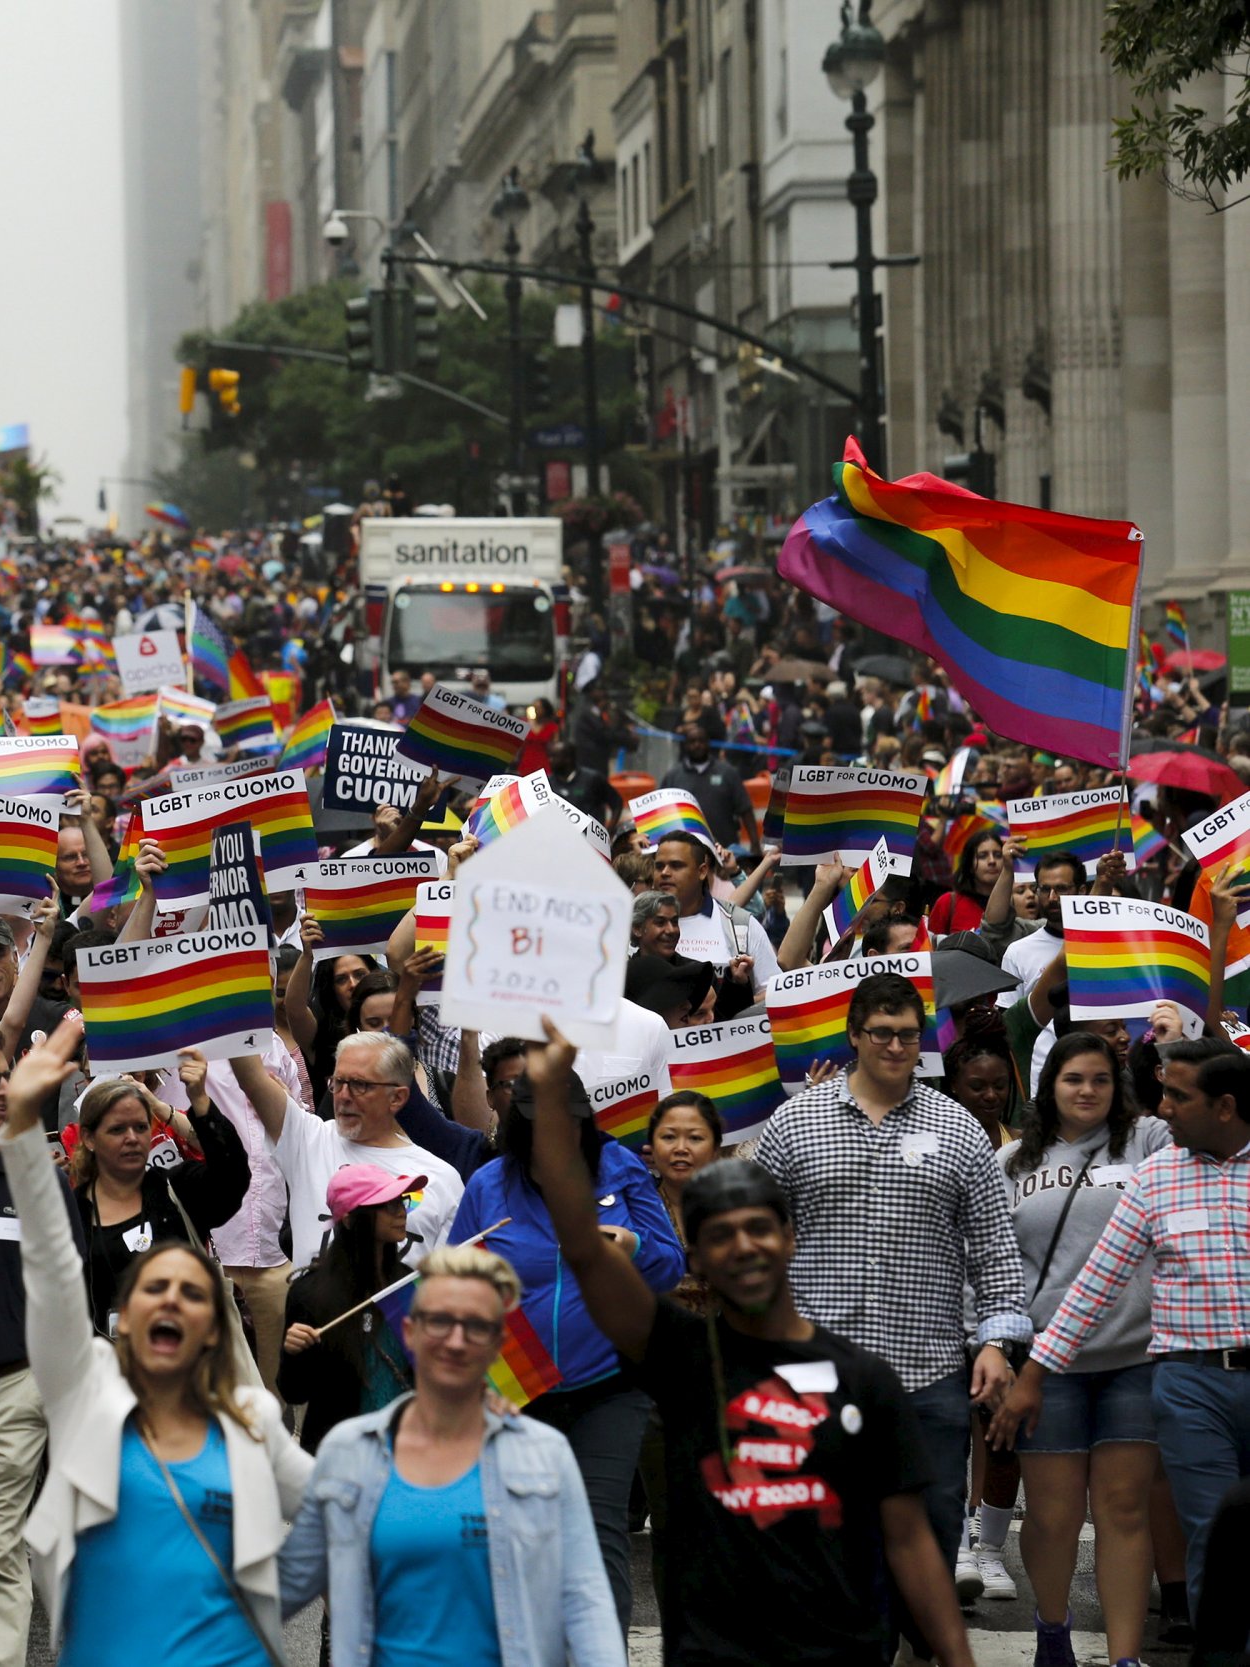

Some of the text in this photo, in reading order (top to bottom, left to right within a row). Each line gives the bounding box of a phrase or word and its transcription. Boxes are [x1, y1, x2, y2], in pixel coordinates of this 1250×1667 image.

[395, 537, 529, 564] sanitation
[126, 661, 181, 683] apicha
[435, 688, 525, 735] LGBT FOR CUOMO
[14, 737, 70, 748] CUOMO
[176, 758, 268, 784] LGBT FOR CUOMO
[798, 769, 834, 783] LGBT
[836, 772, 855, 781] FOR
[857, 772, 918, 790] CUOMO
[149, 774, 295, 816] LGBT FOR CUOMO
[634, 792, 664, 808] LGBT
[1014, 789, 1121, 814] LGBT FOR CUOMO
[590, 824, 608, 845] LGBT
[1192, 807, 1237, 844] LGBT
[219, 831, 245, 865] YOU
[876, 843, 889, 870] LGBT
[320, 861, 431, 876] GBT FOR CUOMO
[492, 886, 540, 914] END
[1072, 900, 1205, 940] LGBT FOR CUOMO
[87, 931, 257, 967] LGBT FOR CUOMO
[774, 957, 920, 992] LGBT FOR CUOMO
[674, 1026, 724, 1048] LGBT
[729, 1024, 756, 1037] FOR
[594, 1074, 651, 1103] CUOMO
[738, 1441, 793, 1465] FREE
[755, 1482, 810, 1507] 2020
